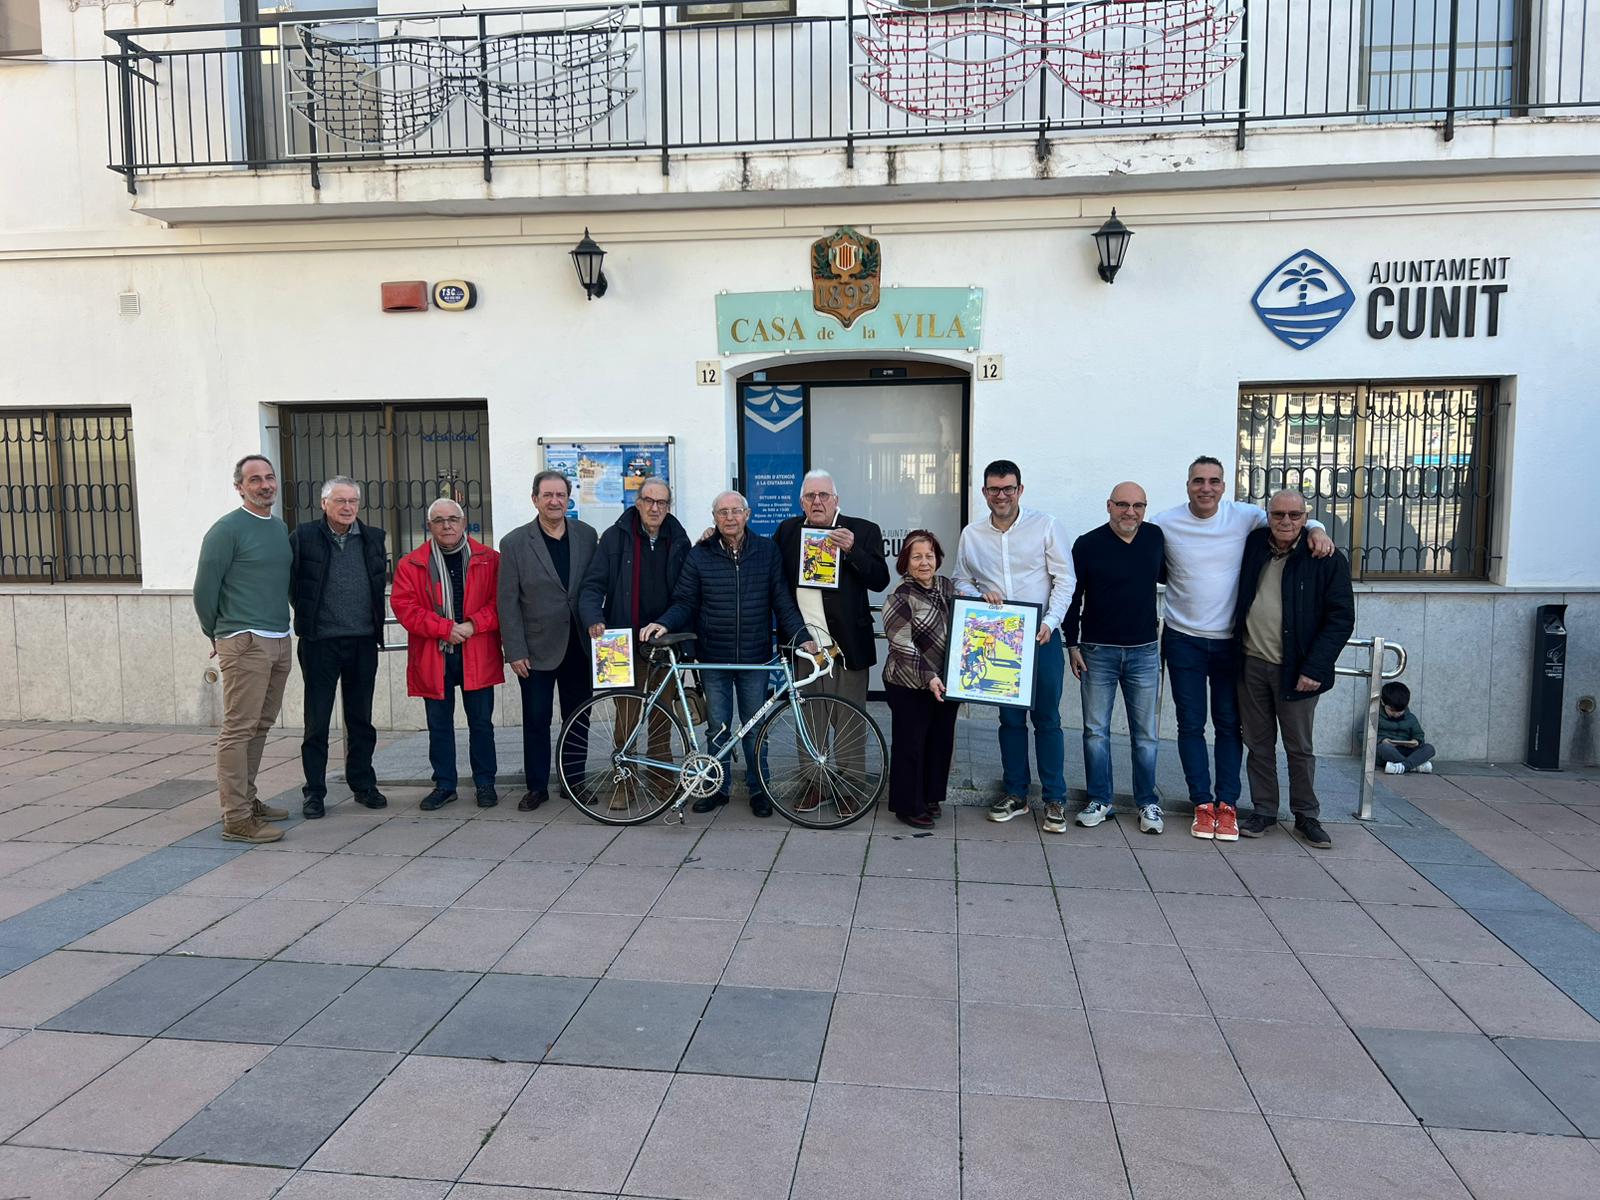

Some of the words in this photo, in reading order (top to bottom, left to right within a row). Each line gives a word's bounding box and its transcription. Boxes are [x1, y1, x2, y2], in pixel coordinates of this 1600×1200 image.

[1369, 257, 1511, 284] AJUNTAMENT
[441, 287, 456, 296] TSC
[818, 281, 874, 309] 1892
[1366, 284, 1509, 340] CUNIT
[730, 317, 807, 343] CASA
[817, 326, 835, 340] de
[862, 325, 876, 340] la
[893, 313, 966, 339] VILA
[702, 369, 716, 383] 12
[983, 364, 998, 379] 12
[421, 434, 449, 442] OLCIA
[882, 529, 909, 538] AJUNTA
[882, 538, 905, 558] CU
